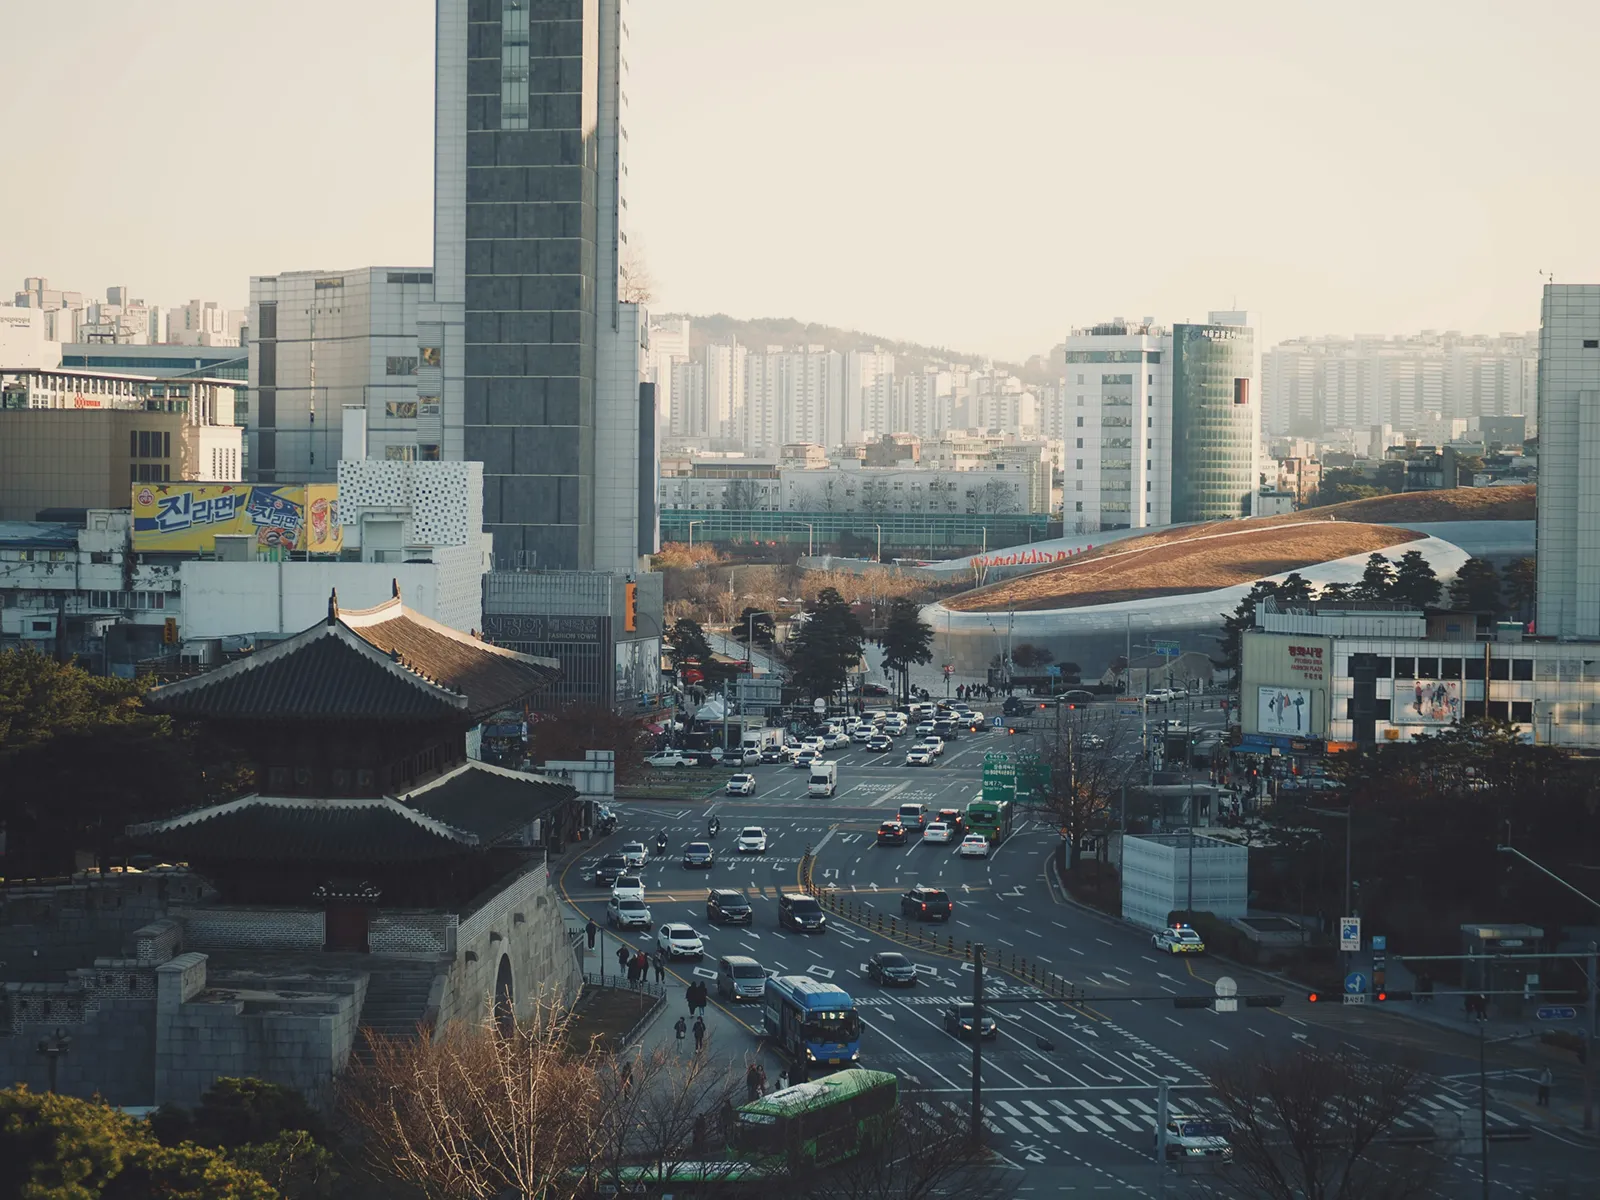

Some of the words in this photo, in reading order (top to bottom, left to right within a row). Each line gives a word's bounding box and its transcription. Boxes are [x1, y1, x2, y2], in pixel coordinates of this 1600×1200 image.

[156, 492, 236, 533] 진라면
[251, 505, 298, 530] 진라면
[485, 617, 543, 639] 신평화
[548, 632, 576, 640] FASHION
[821, 1012, 845, 1020] 162
